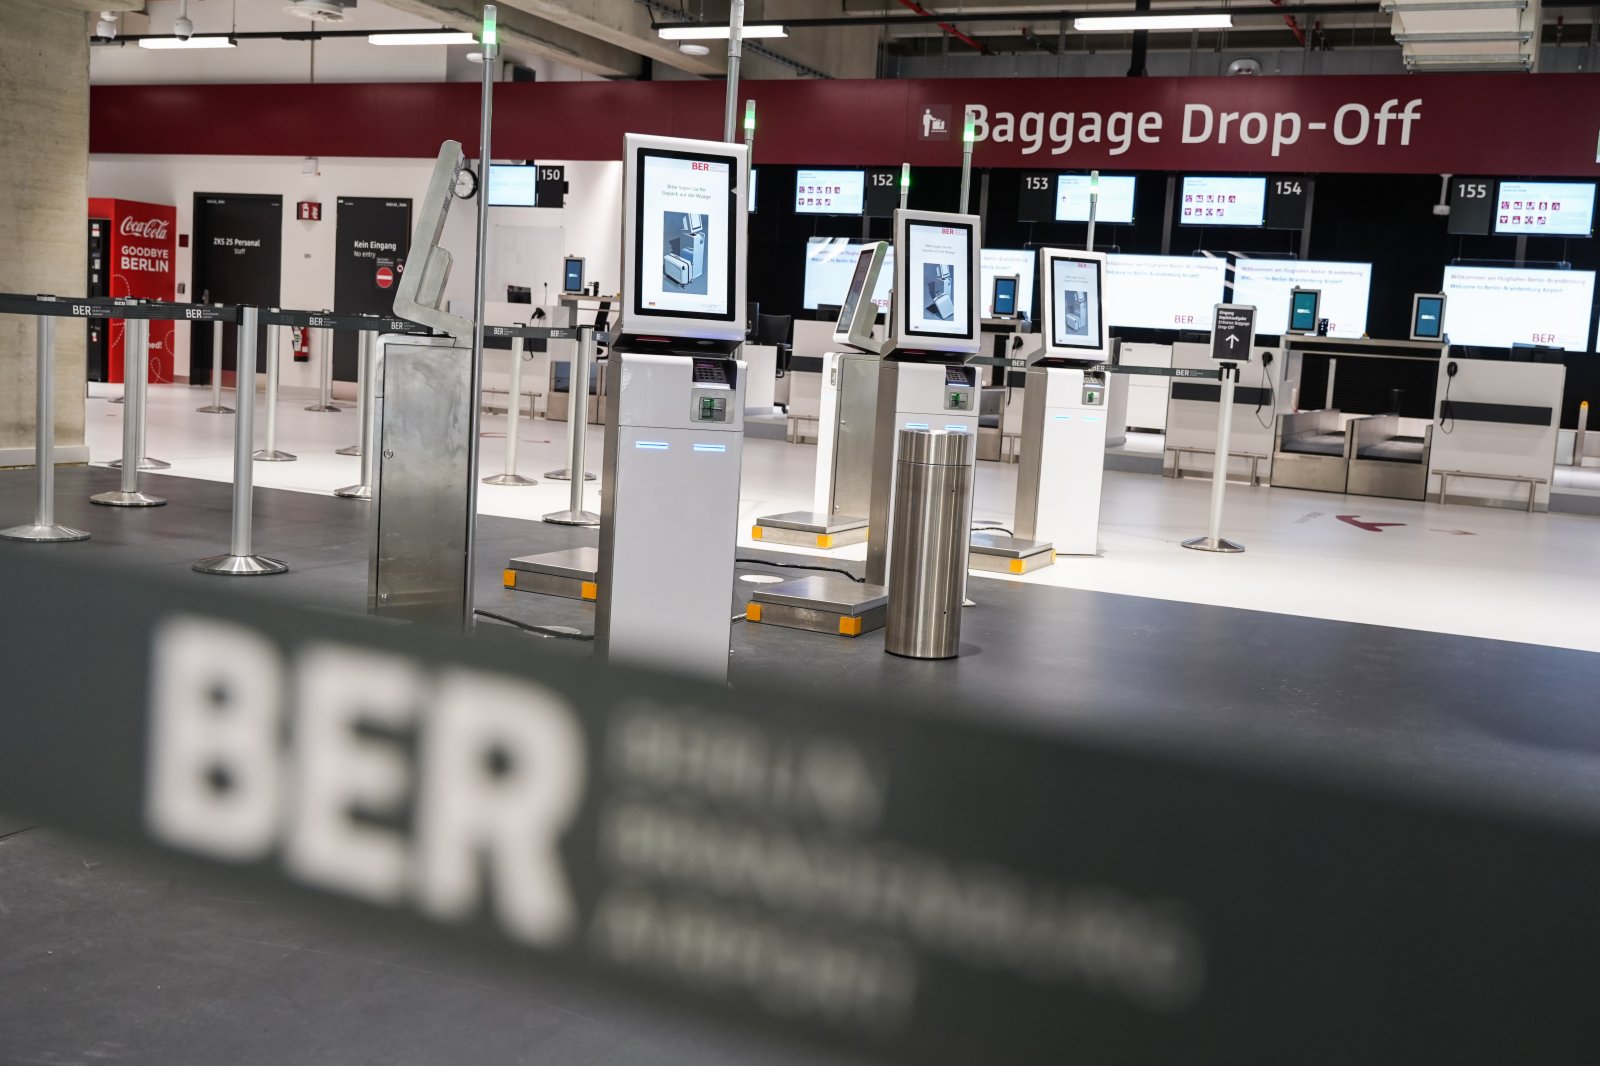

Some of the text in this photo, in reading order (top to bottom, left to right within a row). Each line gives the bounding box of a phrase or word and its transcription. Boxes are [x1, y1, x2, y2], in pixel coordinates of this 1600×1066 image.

[964, 98, 1422, 156] Baggage Drop-Off
[692, 162, 709, 171] BER
[542, 169, 560, 180] 150
[872, 174, 894, 186] 152
[1026, 177, 1048, 190] 153
[1276, 181, 1302, 195] 154
[1458, 184, 1487, 198] 155
[234, 239, 260, 247] Personal
[354, 241, 396, 251] Kein Eingang
[122, 246, 168, 259] GOODBYE
[121, 257, 169, 272] BERLIN
[72, 305, 92, 316] BER
[186, 308, 202, 319] BER
[309, 317, 323, 326] BER
[1174, 315, 1194, 324] BER
[1532, 333, 1555, 343] BER
[148, 612, 587, 944] BER
